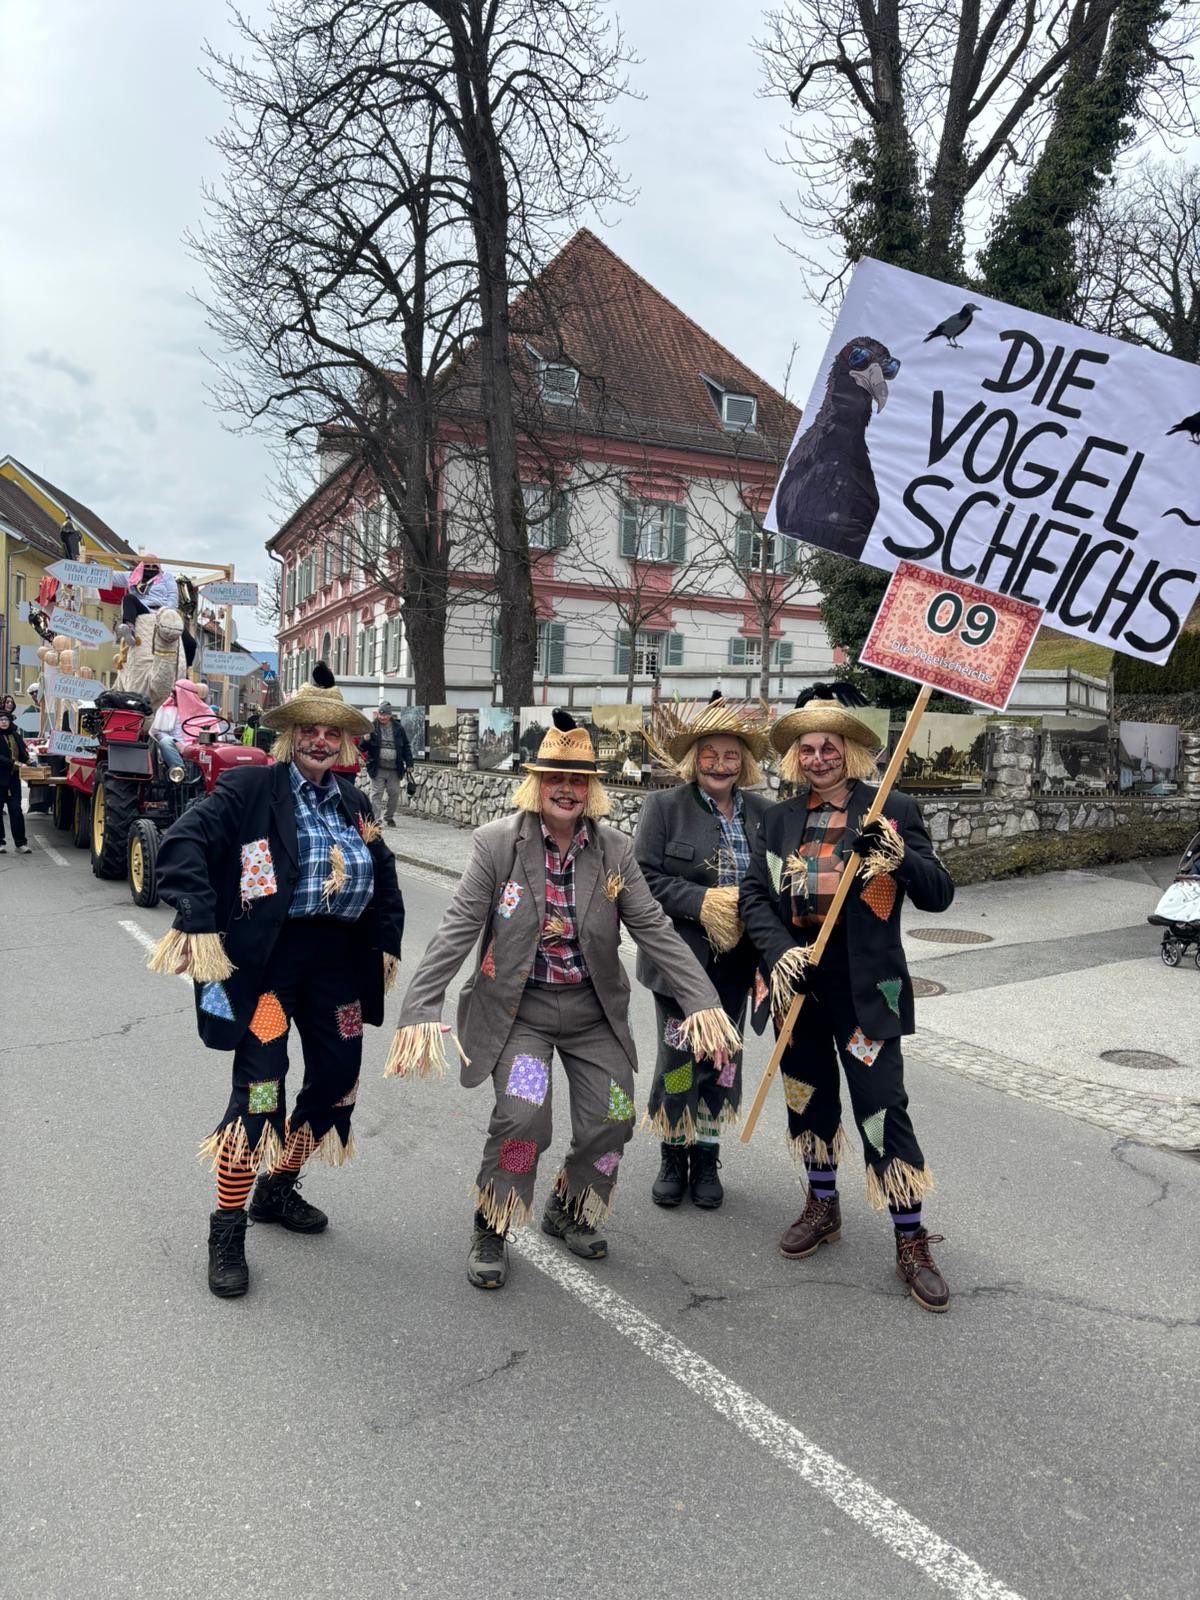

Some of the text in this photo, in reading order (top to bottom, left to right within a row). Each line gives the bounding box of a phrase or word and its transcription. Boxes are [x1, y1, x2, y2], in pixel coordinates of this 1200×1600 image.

[981, 329, 1110, 419] DIE
[882, 474, 1197, 653] SCHEICHS
[926, 590, 998, 648] 09
[890, 639, 993, 683] Die Vogelscheichs
